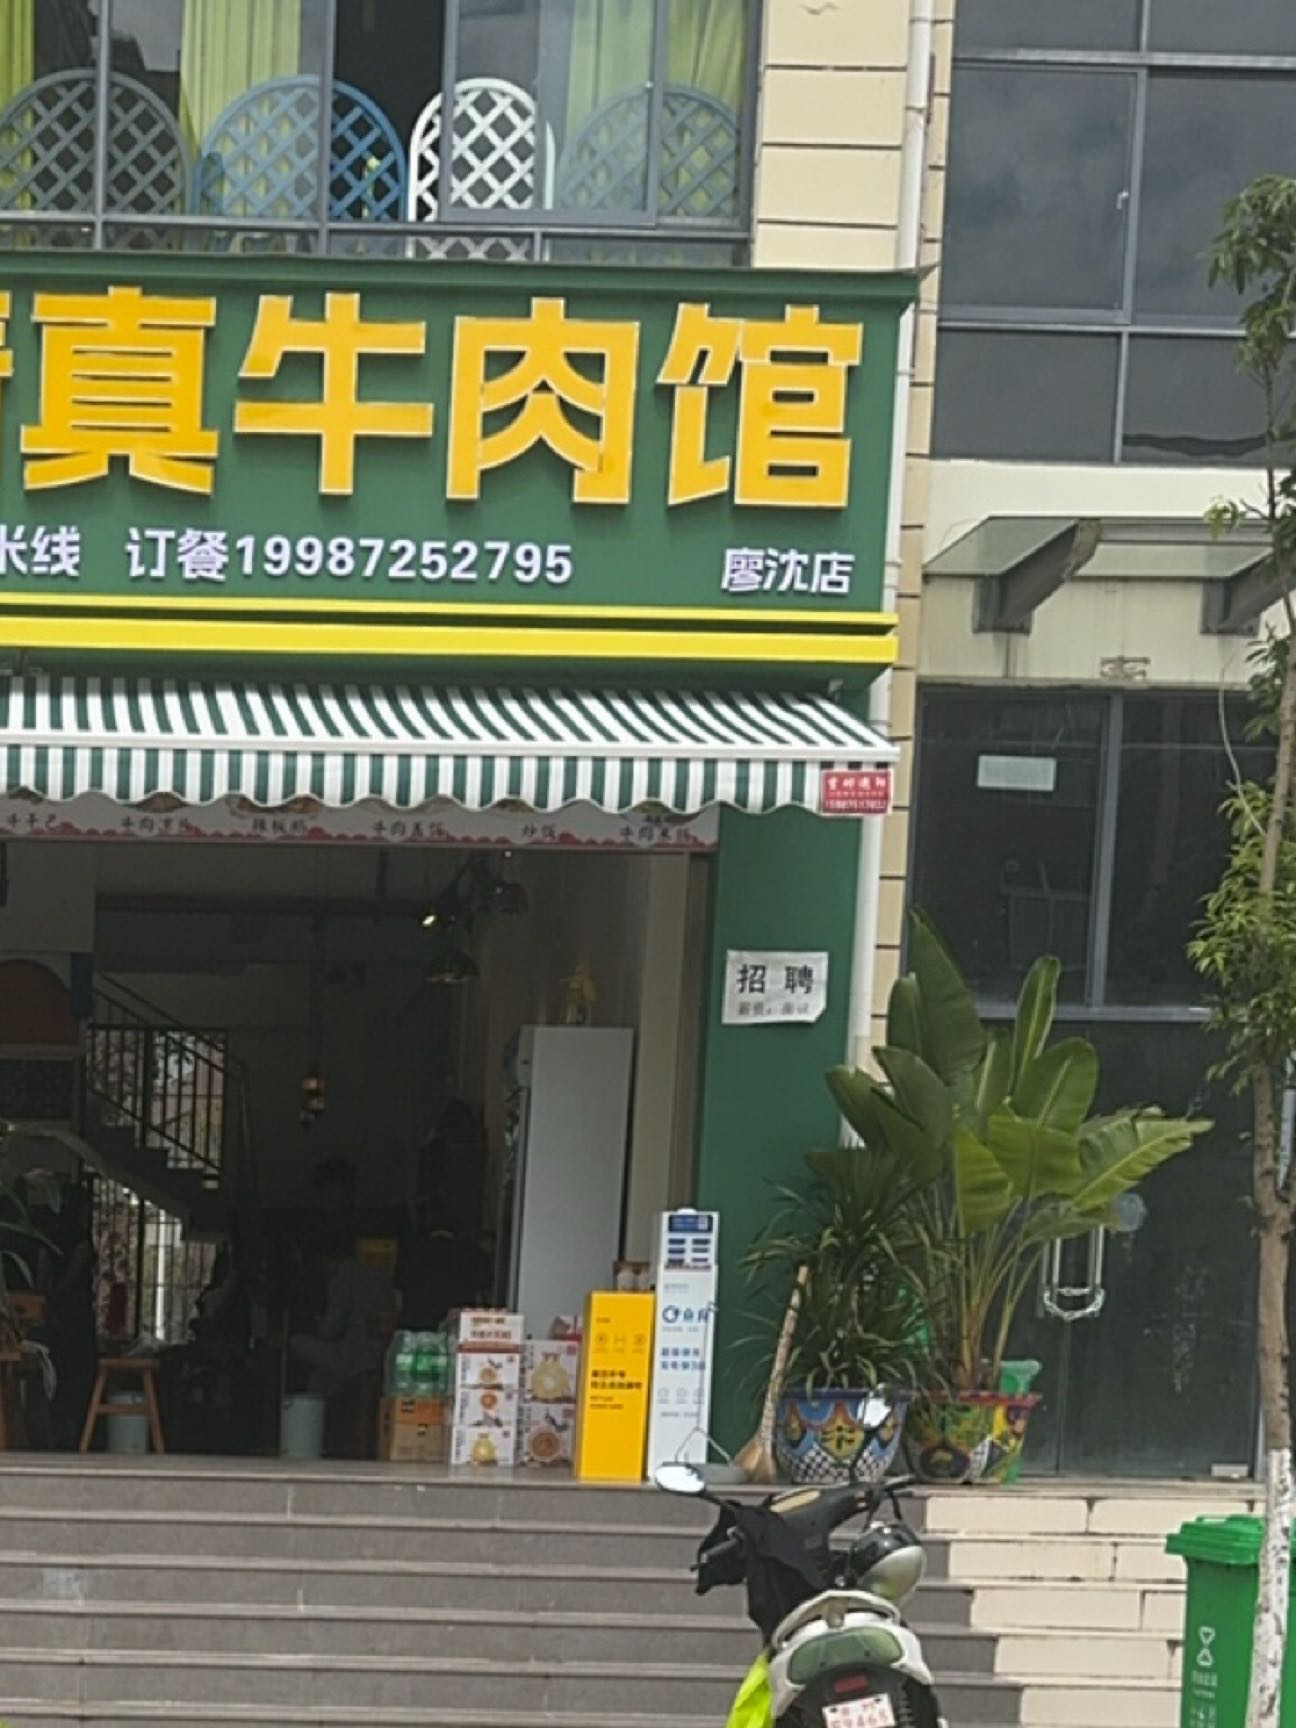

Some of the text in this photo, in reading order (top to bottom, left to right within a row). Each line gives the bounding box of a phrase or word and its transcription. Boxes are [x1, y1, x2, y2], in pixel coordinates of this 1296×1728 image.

[721, 547, 856, 594] 廖沈店
[736, 964, 814, 994] 招聘
